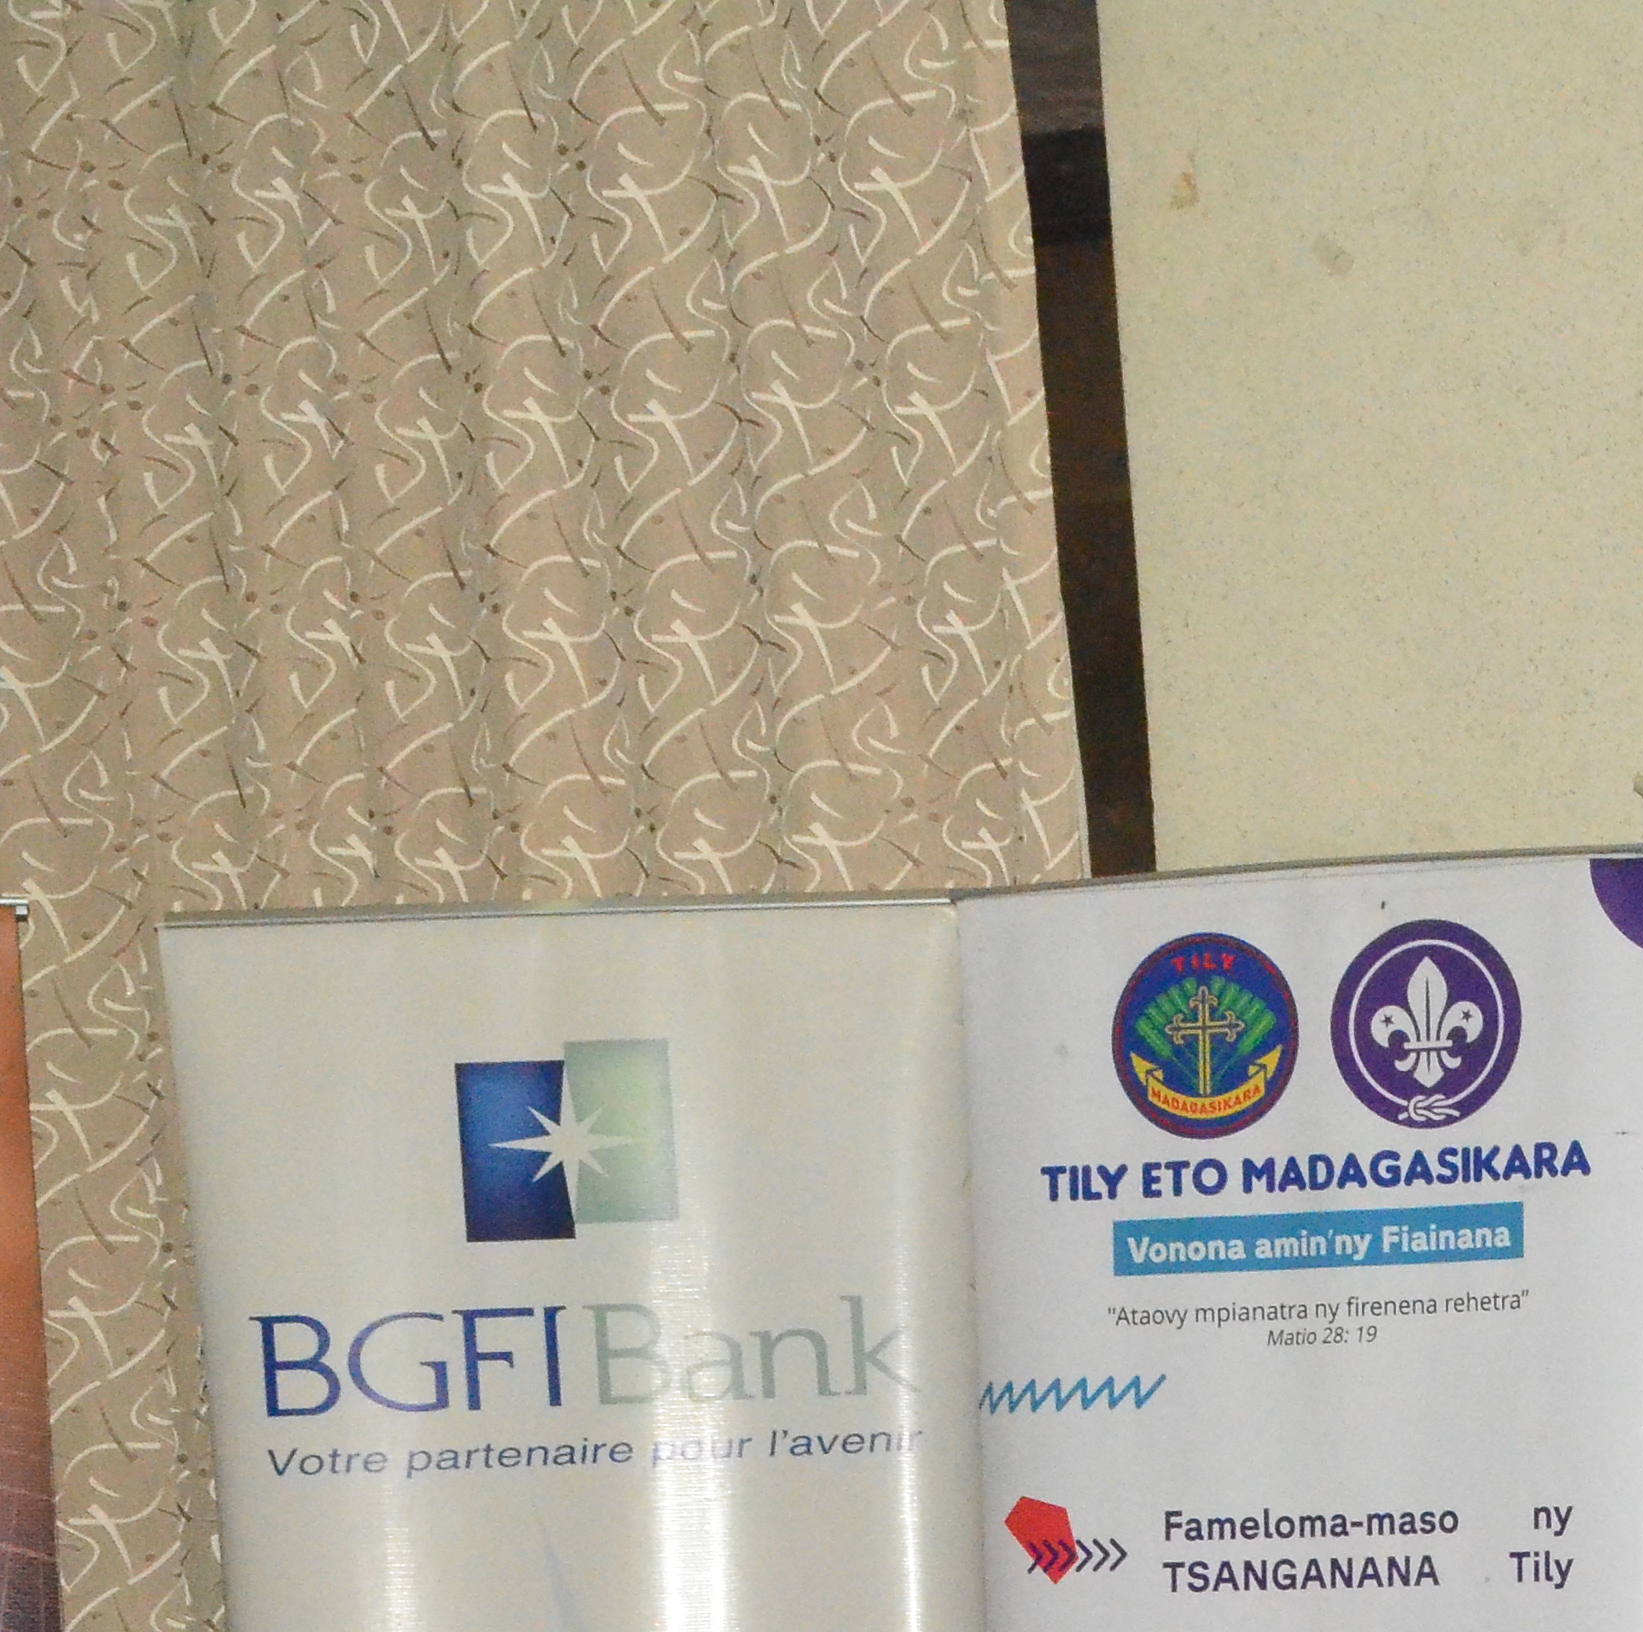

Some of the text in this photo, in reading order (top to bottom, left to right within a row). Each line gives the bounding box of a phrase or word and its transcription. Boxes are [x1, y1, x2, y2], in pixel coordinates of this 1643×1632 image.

[1171, 953, 1237, 973] TILY
[1151, 1083, 1263, 1116] MADAGASIKARA
[1040, 1139, 1592, 1203] TILY ETO MADAGASIKARA
[1127, 1223, 1511, 1265] Vonona amin'ny Fiainana
[1194, 1299, 1308, 1328] mpianatra
[1313, 1301, 1341, 1325] ny
[1346, 1293, 1438, 1319] firenena
[1267, 1326, 1319, 1348] Matio
[1355, 1325, 1379, 1345] 19
[267, 1427, 925, 1480] Votre partenaire pour l'avenir
[1163, 1505, 1574, 1544] Fameloma-maso ny
[1163, 1551, 1575, 1594] TSANGANANA Tily
